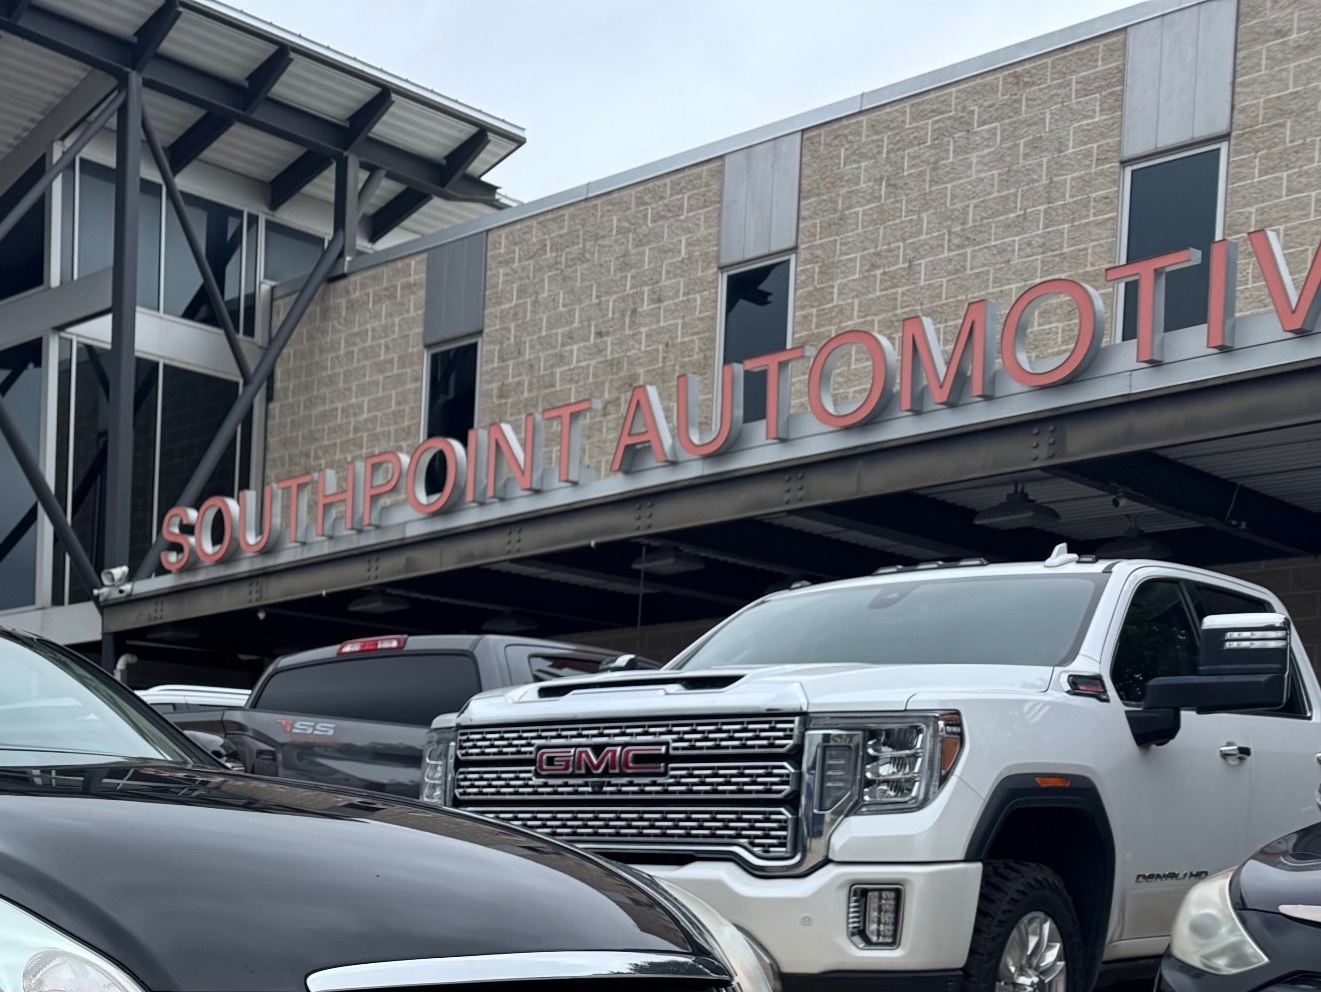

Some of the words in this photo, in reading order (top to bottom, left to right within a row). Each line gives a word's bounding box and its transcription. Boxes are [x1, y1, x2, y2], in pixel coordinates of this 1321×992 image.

[160, 402, 593, 572] SOUTHPOINT
[610, 228, 1321, 474] AUTOMOTIV
[536, 745, 666, 775] GMC
